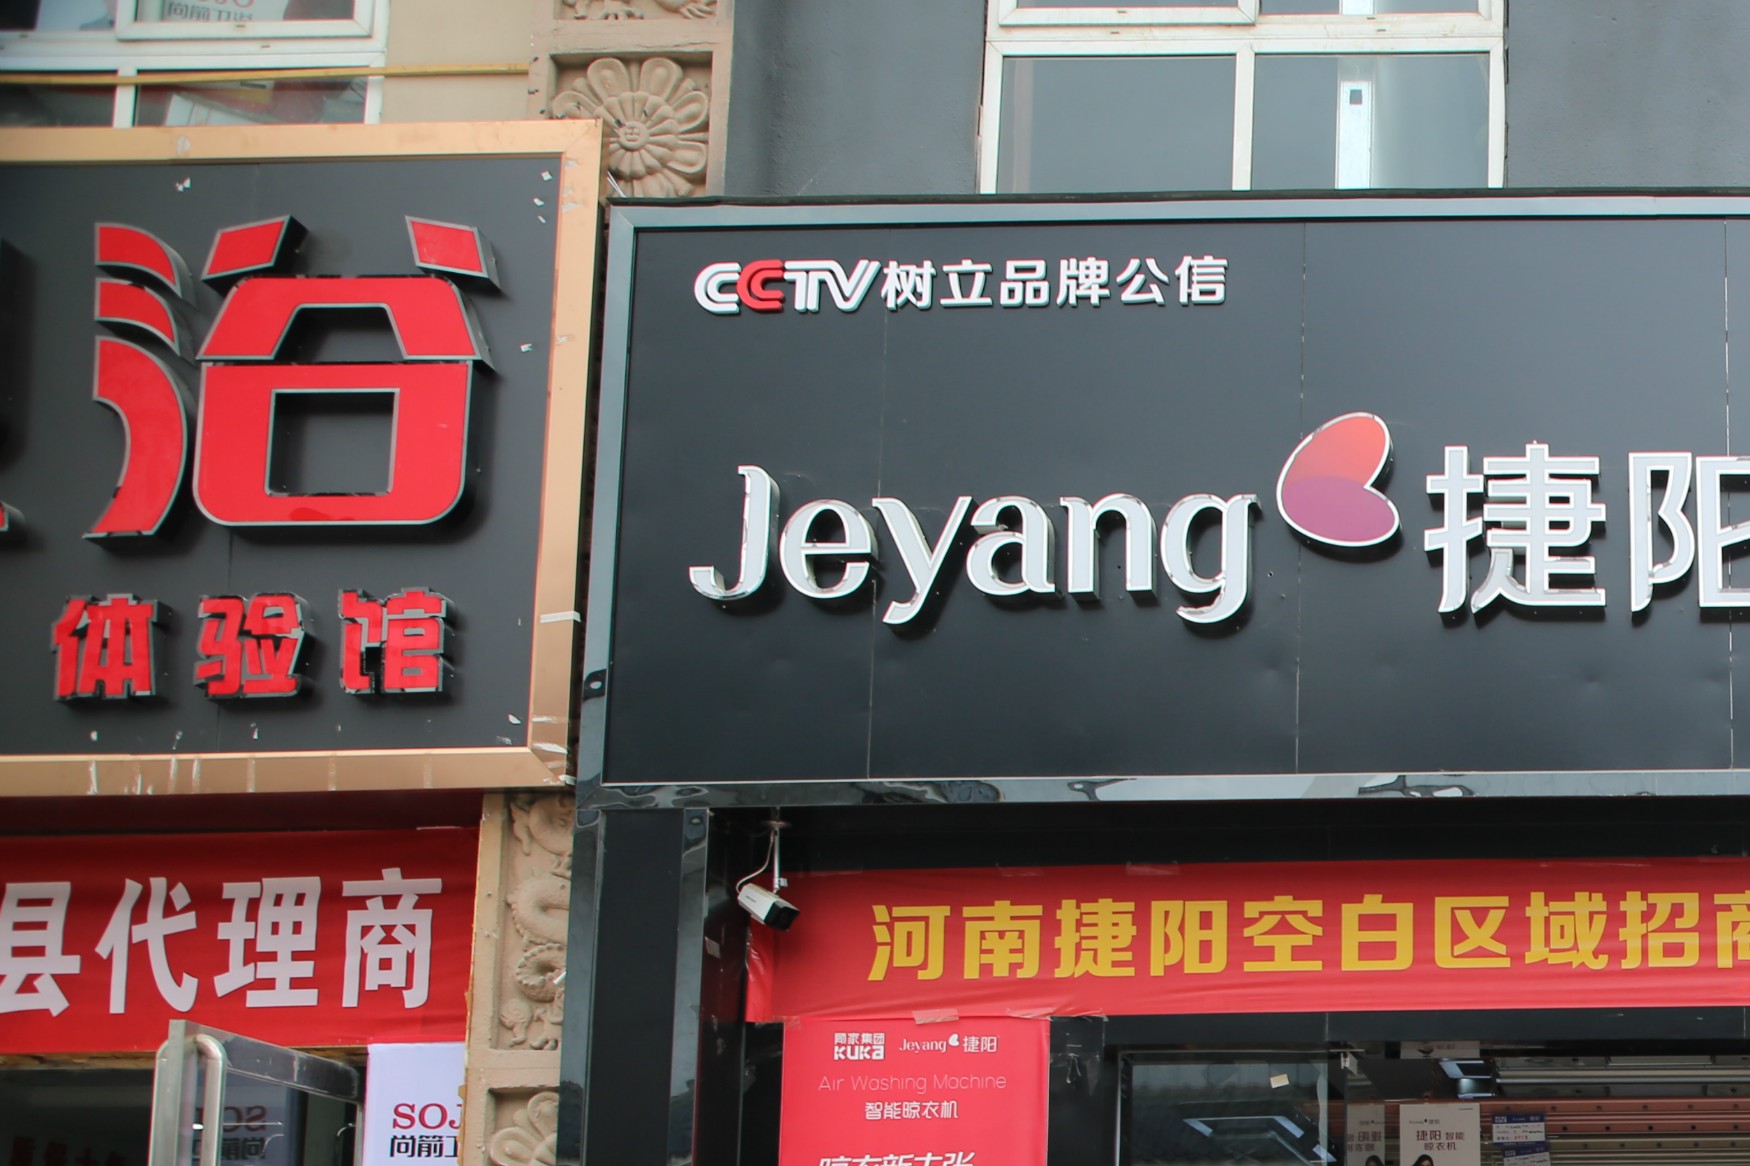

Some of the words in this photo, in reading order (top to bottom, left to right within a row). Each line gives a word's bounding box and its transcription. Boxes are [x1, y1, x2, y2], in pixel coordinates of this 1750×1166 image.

[694, 259, 881, 314] CCTV
[881, 255, 1229, 310] 树立品牌公信
[688, 465, 1262, 625] Jeyang
[52, 587, 451, 700] 体验馆
[0, 867, 443, 1018] 县代理商
[899, 1037, 947, 1053] Jeyang
[962, 1036, 998, 1053] 捷阳
[818, 1075, 842, 1091] Air
[851, 1075, 928, 1094] Washing
[933, 1073, 1007, 1089] Machine
[865, 1100, 959, 1120] 智能晾衣机
